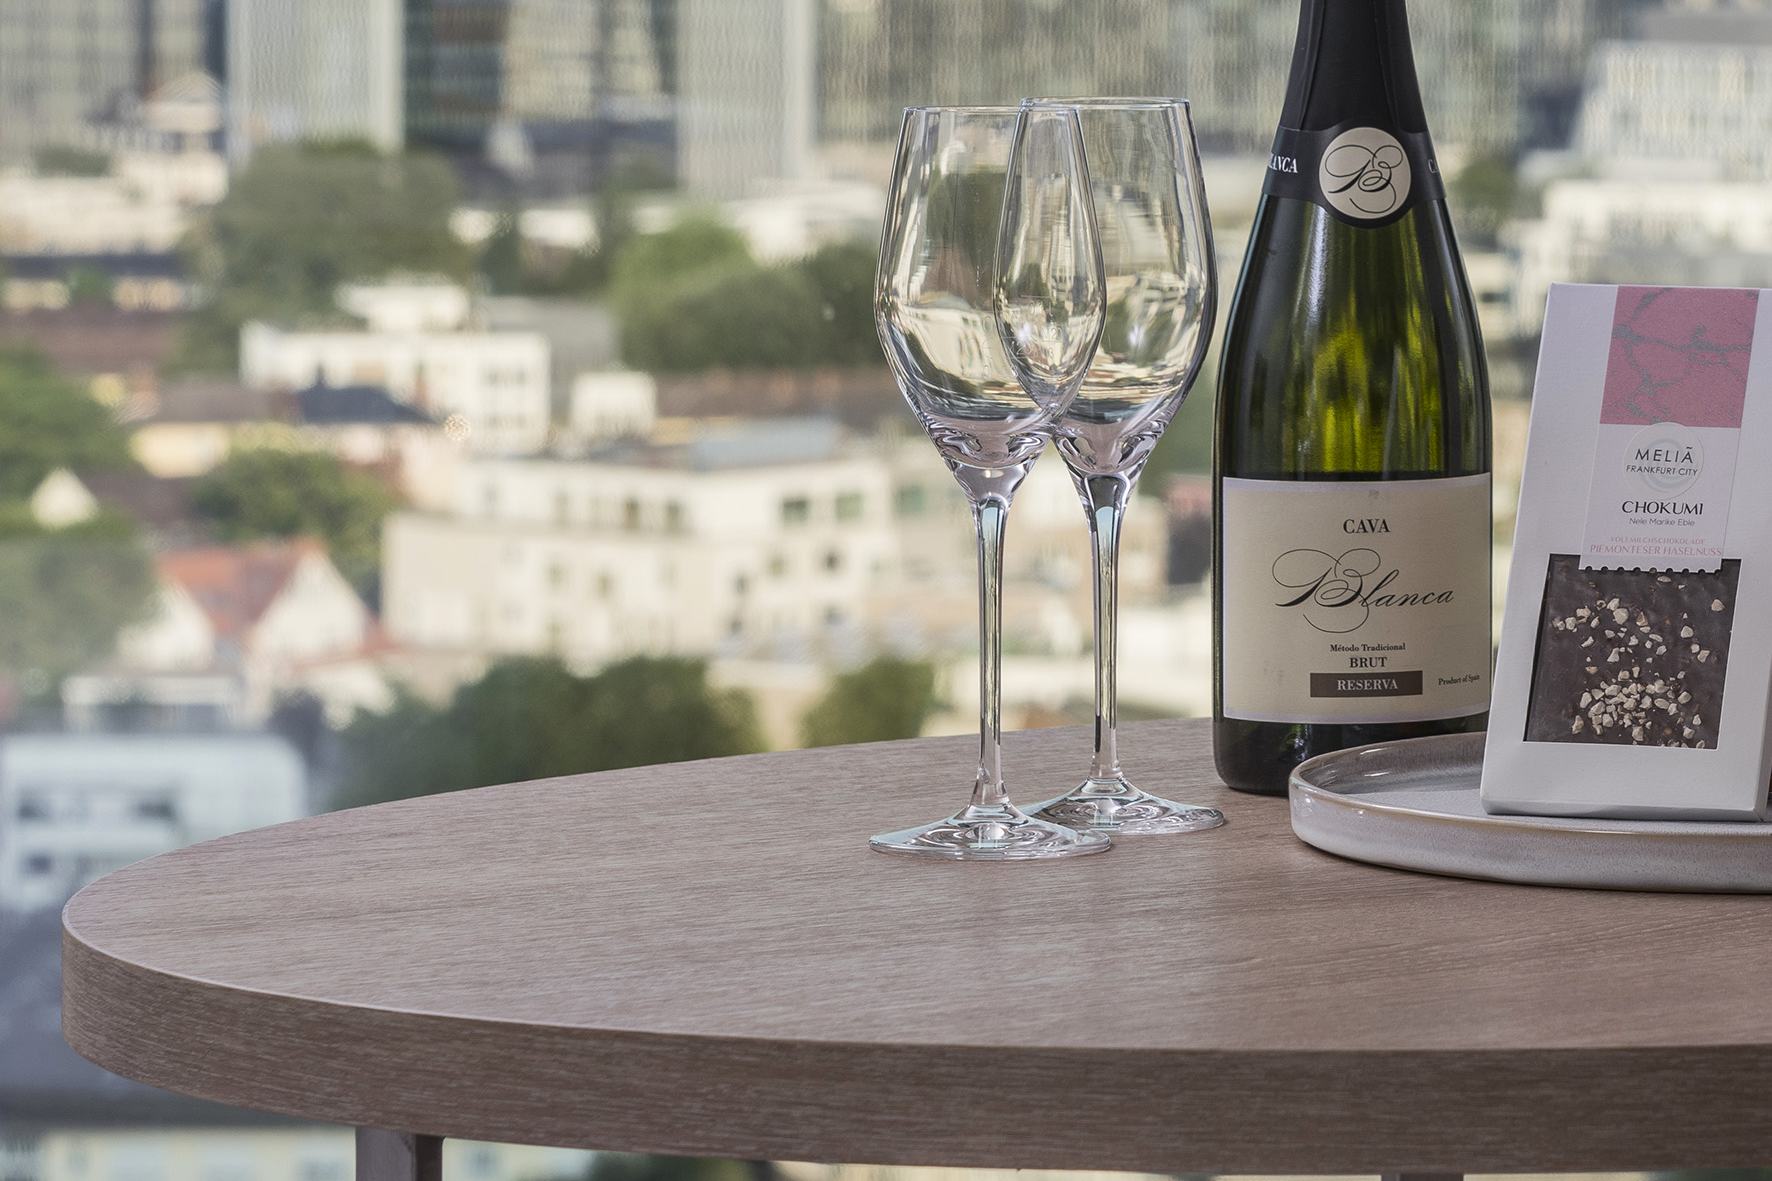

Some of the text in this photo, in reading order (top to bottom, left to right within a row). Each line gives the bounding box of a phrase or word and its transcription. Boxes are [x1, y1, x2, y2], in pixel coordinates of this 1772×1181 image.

[1626, 464, 1699, 476] FRANKFURT CITY
[1621, 500, 1704, 516] CHOKUMI
[1343, 519, 1391, 534] CAVA
[1629, 517, 1648, 525] Nele
[1677, 518, 1695, 527] Eble
[1589, 544, 1723, 557] PIEMONTESER HASELNUSS
[1272, 548, 1455, 634] Blanca
[1330, 643, 1406, 652] Método Tradicional
[1350, 657, 1388, 668] BRUT
[1337, 679, 1399, 691] RESERVA
